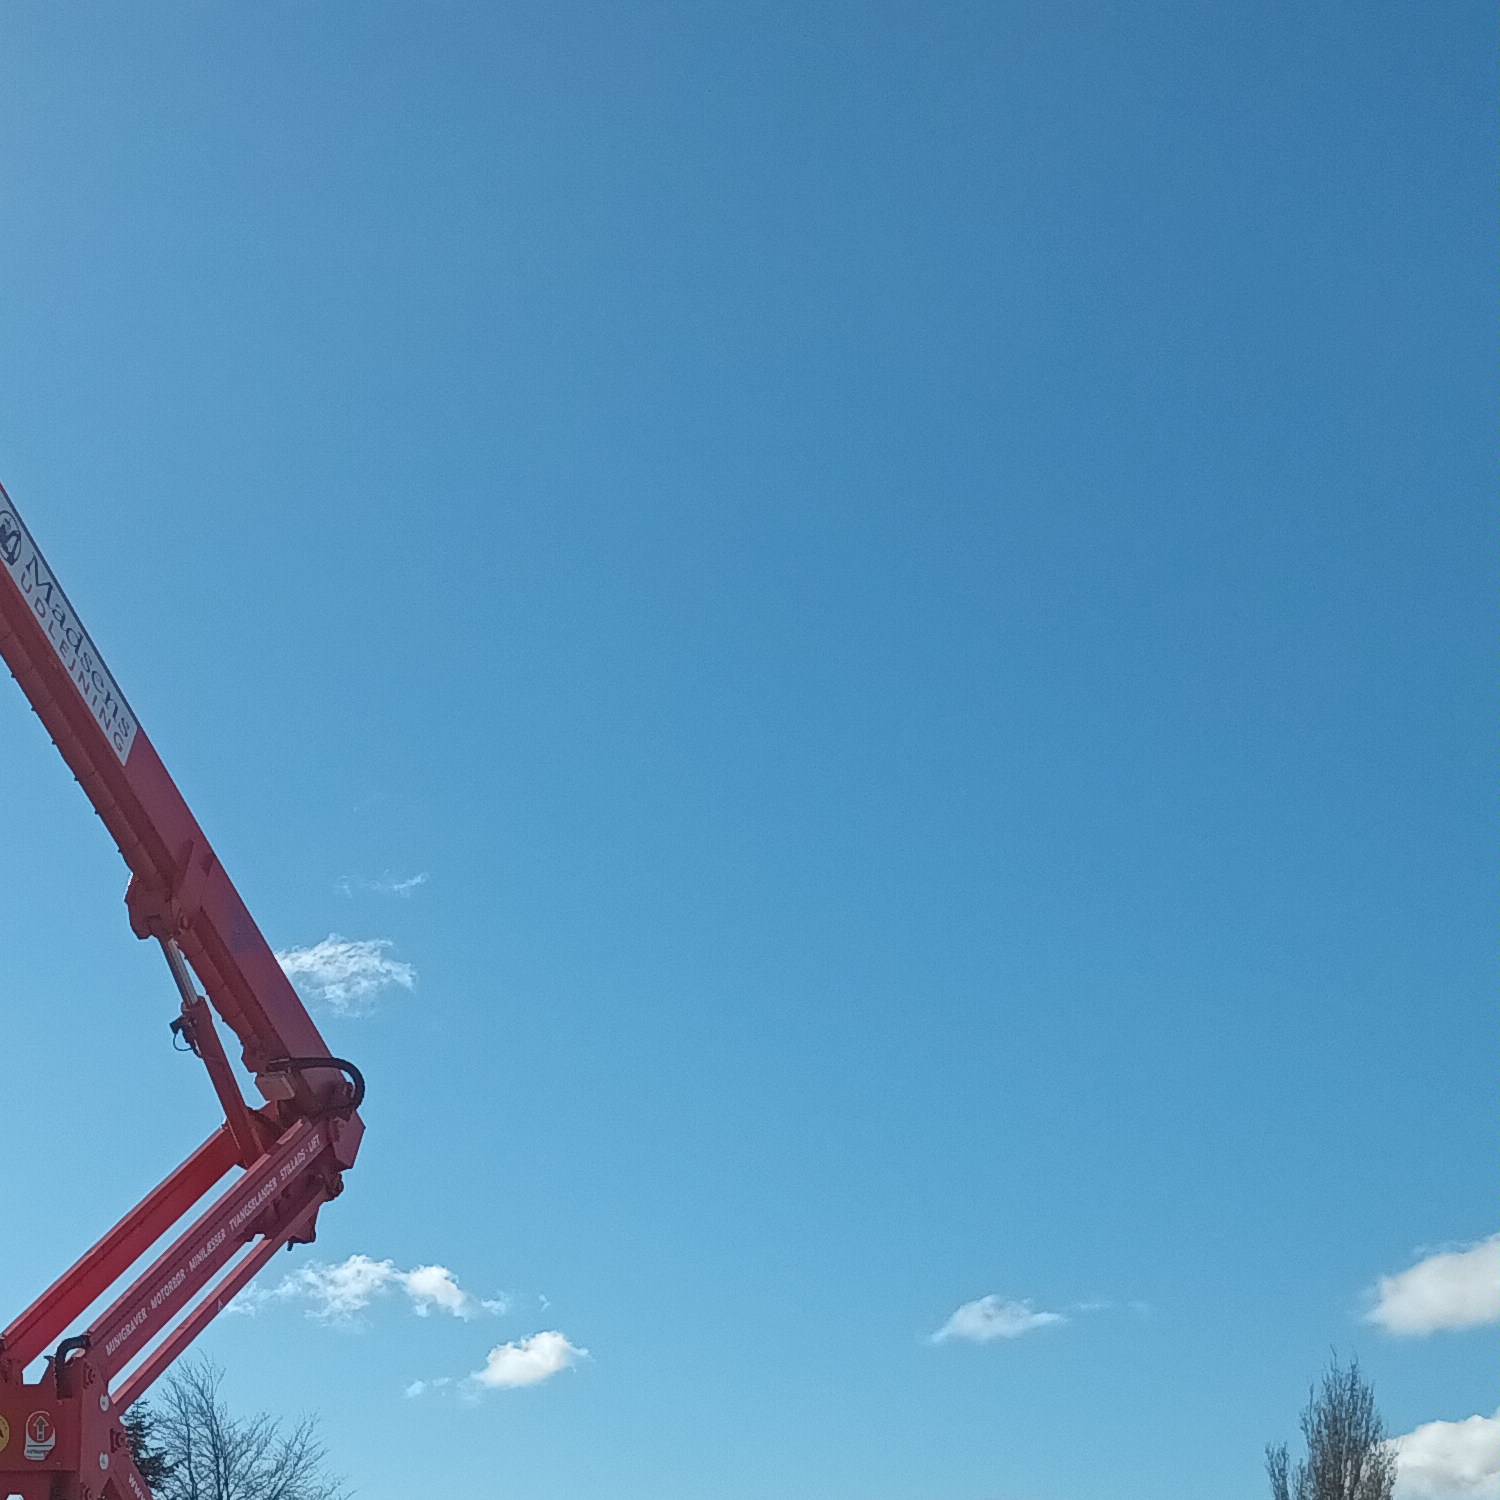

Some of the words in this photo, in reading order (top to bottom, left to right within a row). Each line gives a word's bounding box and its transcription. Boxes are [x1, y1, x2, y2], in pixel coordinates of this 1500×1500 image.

[21, 571, 123, 752] UDLEJNING
[25, 552, 130, 738] Madsens
[105, 1307, 148, 1356] MINIGRAVER
[308, 1134, 320, 1152] LIFT
